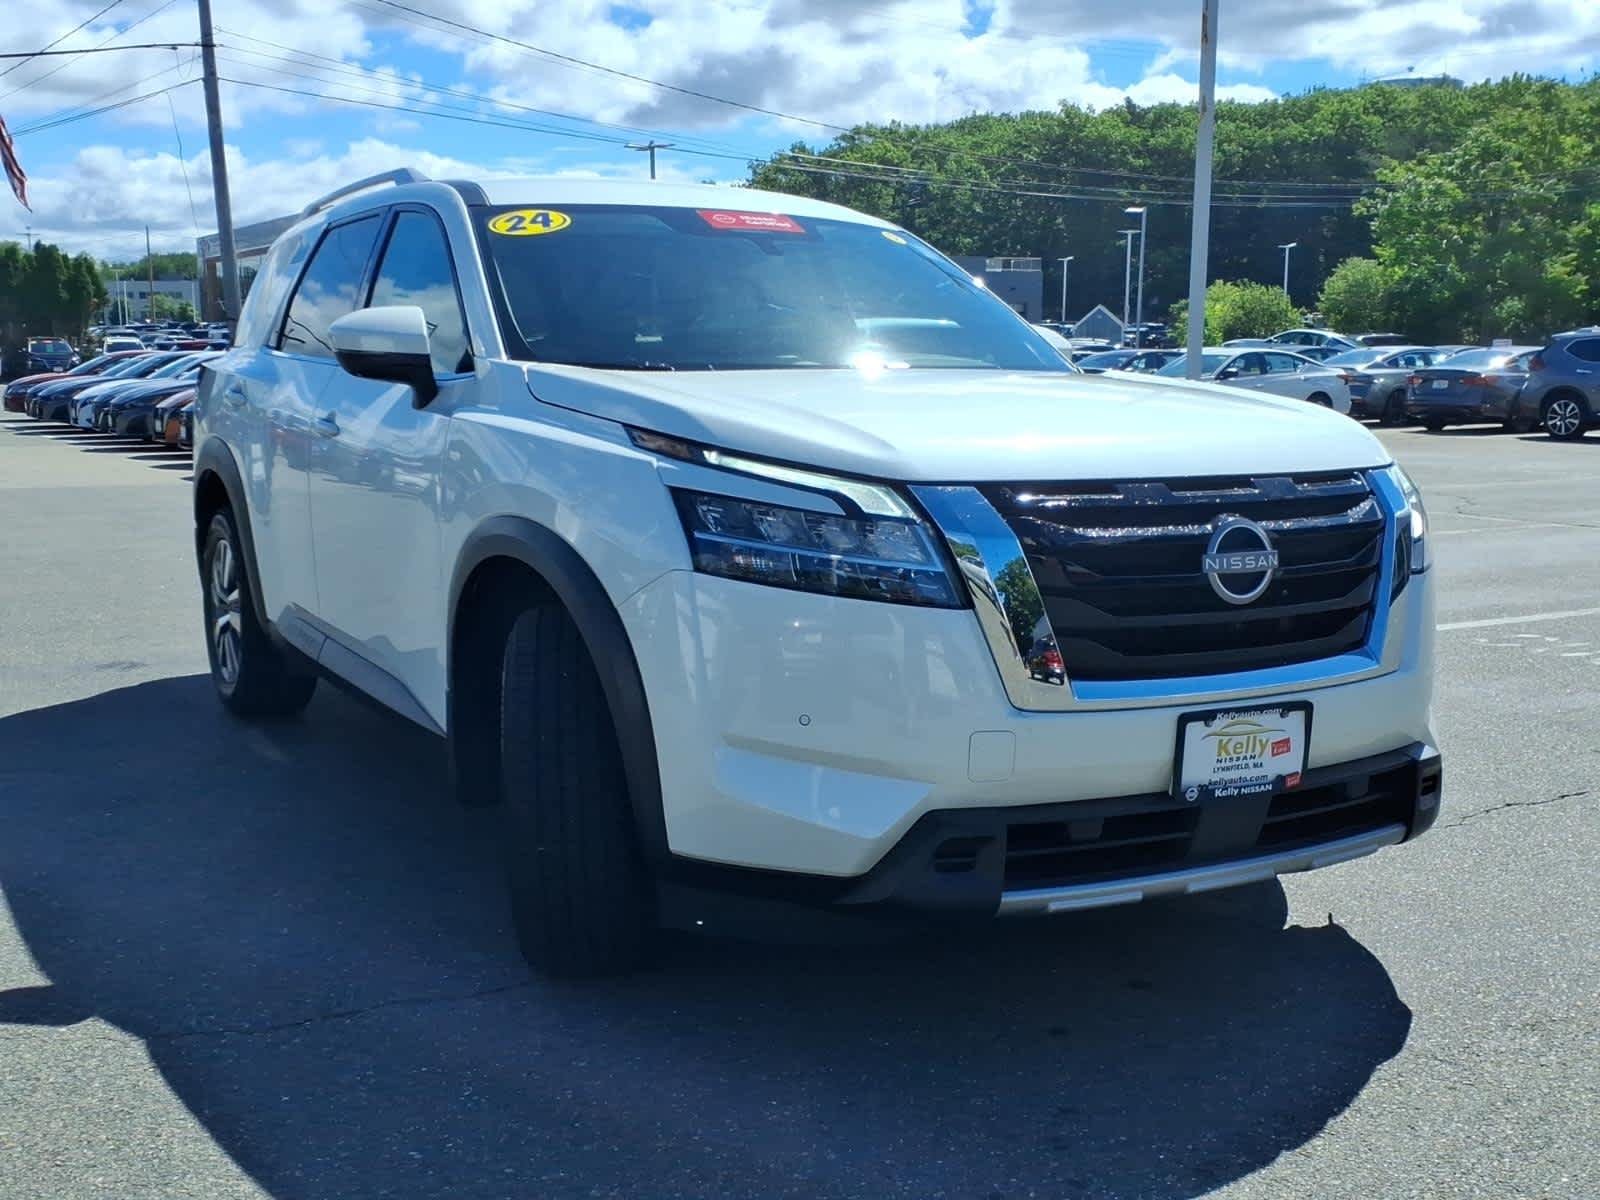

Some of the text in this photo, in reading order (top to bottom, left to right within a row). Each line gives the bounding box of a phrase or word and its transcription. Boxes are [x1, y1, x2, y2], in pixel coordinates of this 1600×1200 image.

[504, 212, 553, 232] 24
[1205, 554, 1278, 570] NISSAN
[1217, 735, 1269, 758] Kelly
[1216, 754, 1257, 764] NISSAN
[1208, 774, 1269, 787] kellyauto.com
[1215, 783, 1273, 798] Kelly NISSAN
